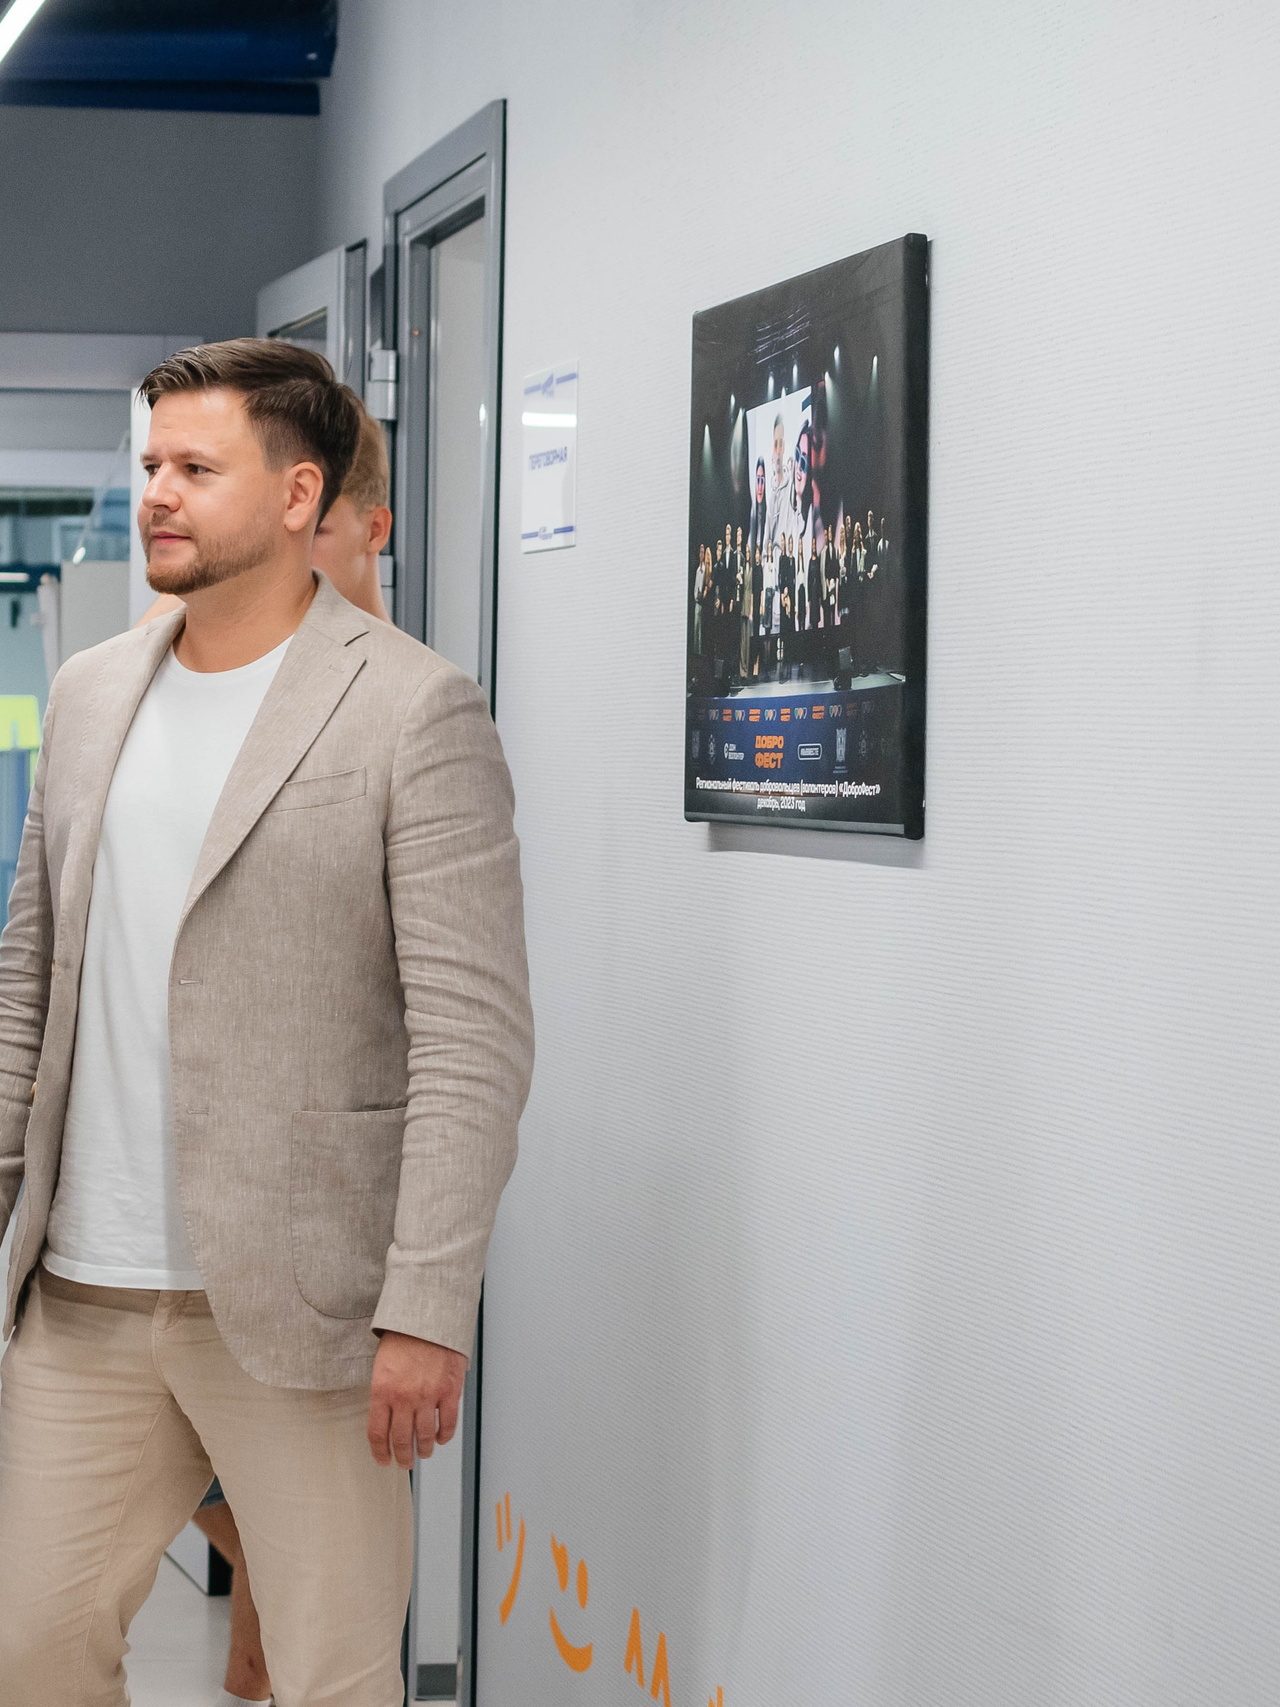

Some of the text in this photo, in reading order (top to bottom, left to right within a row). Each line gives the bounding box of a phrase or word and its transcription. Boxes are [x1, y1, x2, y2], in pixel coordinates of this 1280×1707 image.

[755, 735, 784, 749] ДОБРО
[755, 752, 784, 769] ФЕСТ
[695, 776, 732, 790] Региональный
[732, 778, 760, 792] фестиваль
[759, 779, 800, 795] добровольцев
[780, 796, 795, 810] 2023
[795, 800, 806, 812] год
